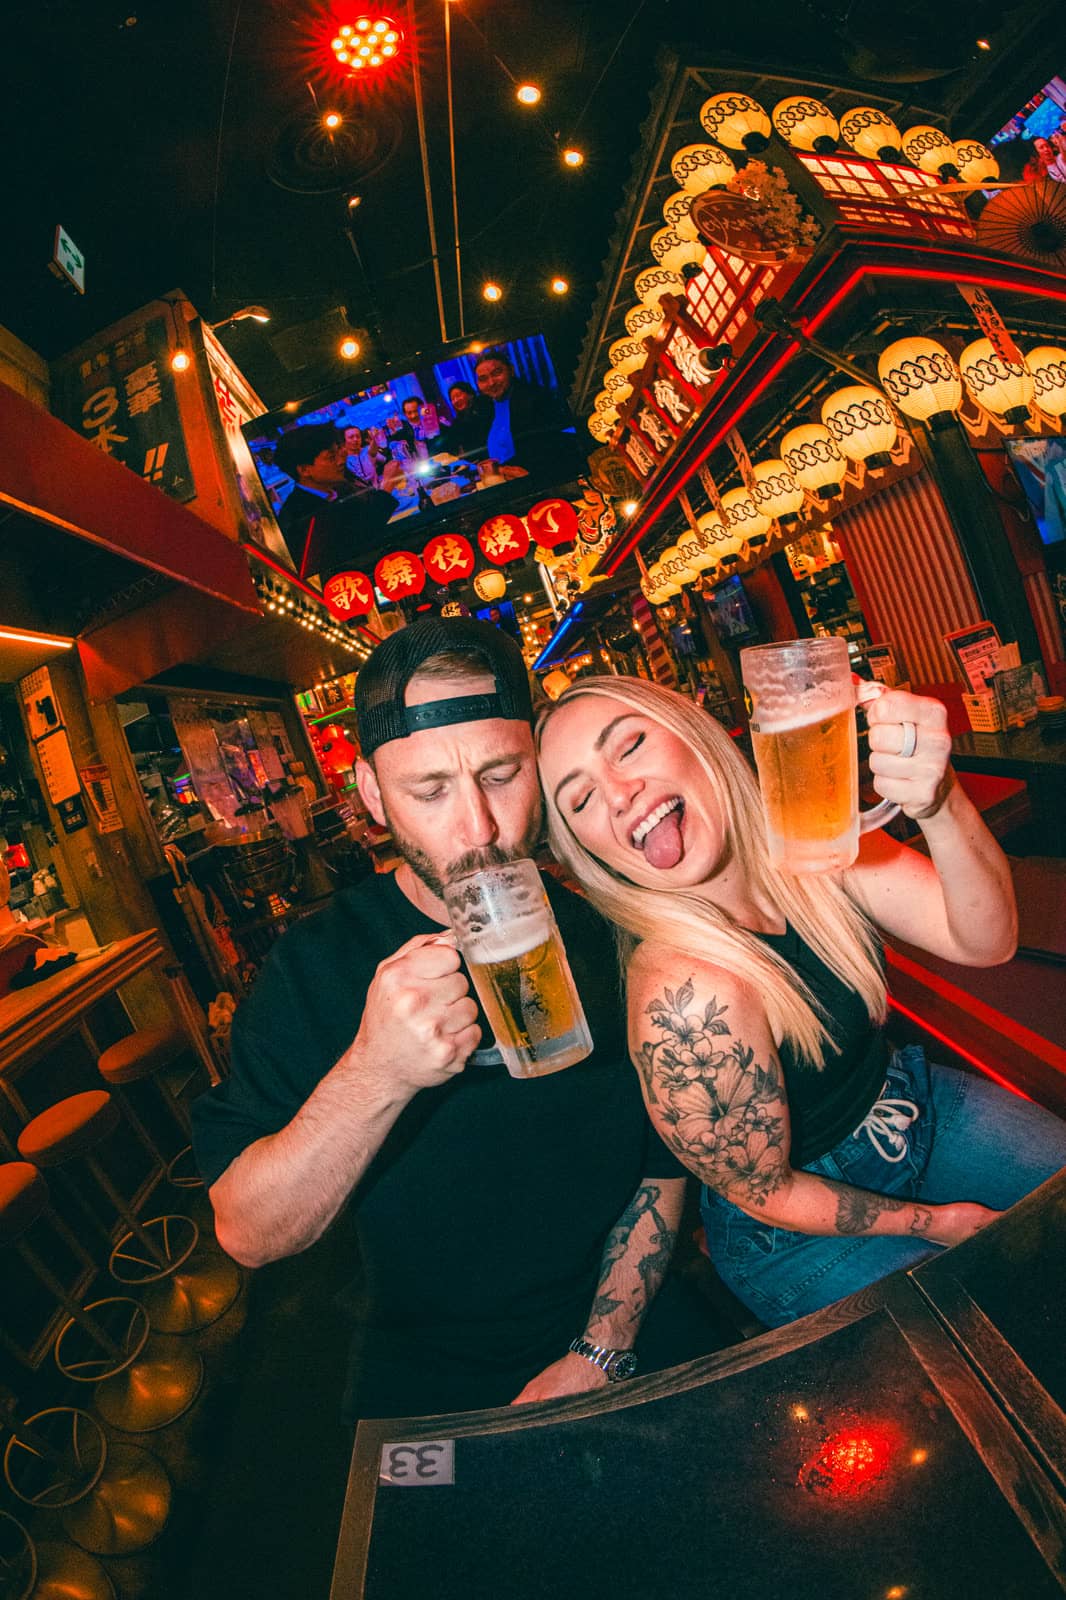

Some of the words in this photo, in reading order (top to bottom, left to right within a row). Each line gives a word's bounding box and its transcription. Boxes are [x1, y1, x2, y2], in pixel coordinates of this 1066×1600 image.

[329, 502, 561, 610] 歌舞伎横丁
[389, 1444, 444, 1478] 33
